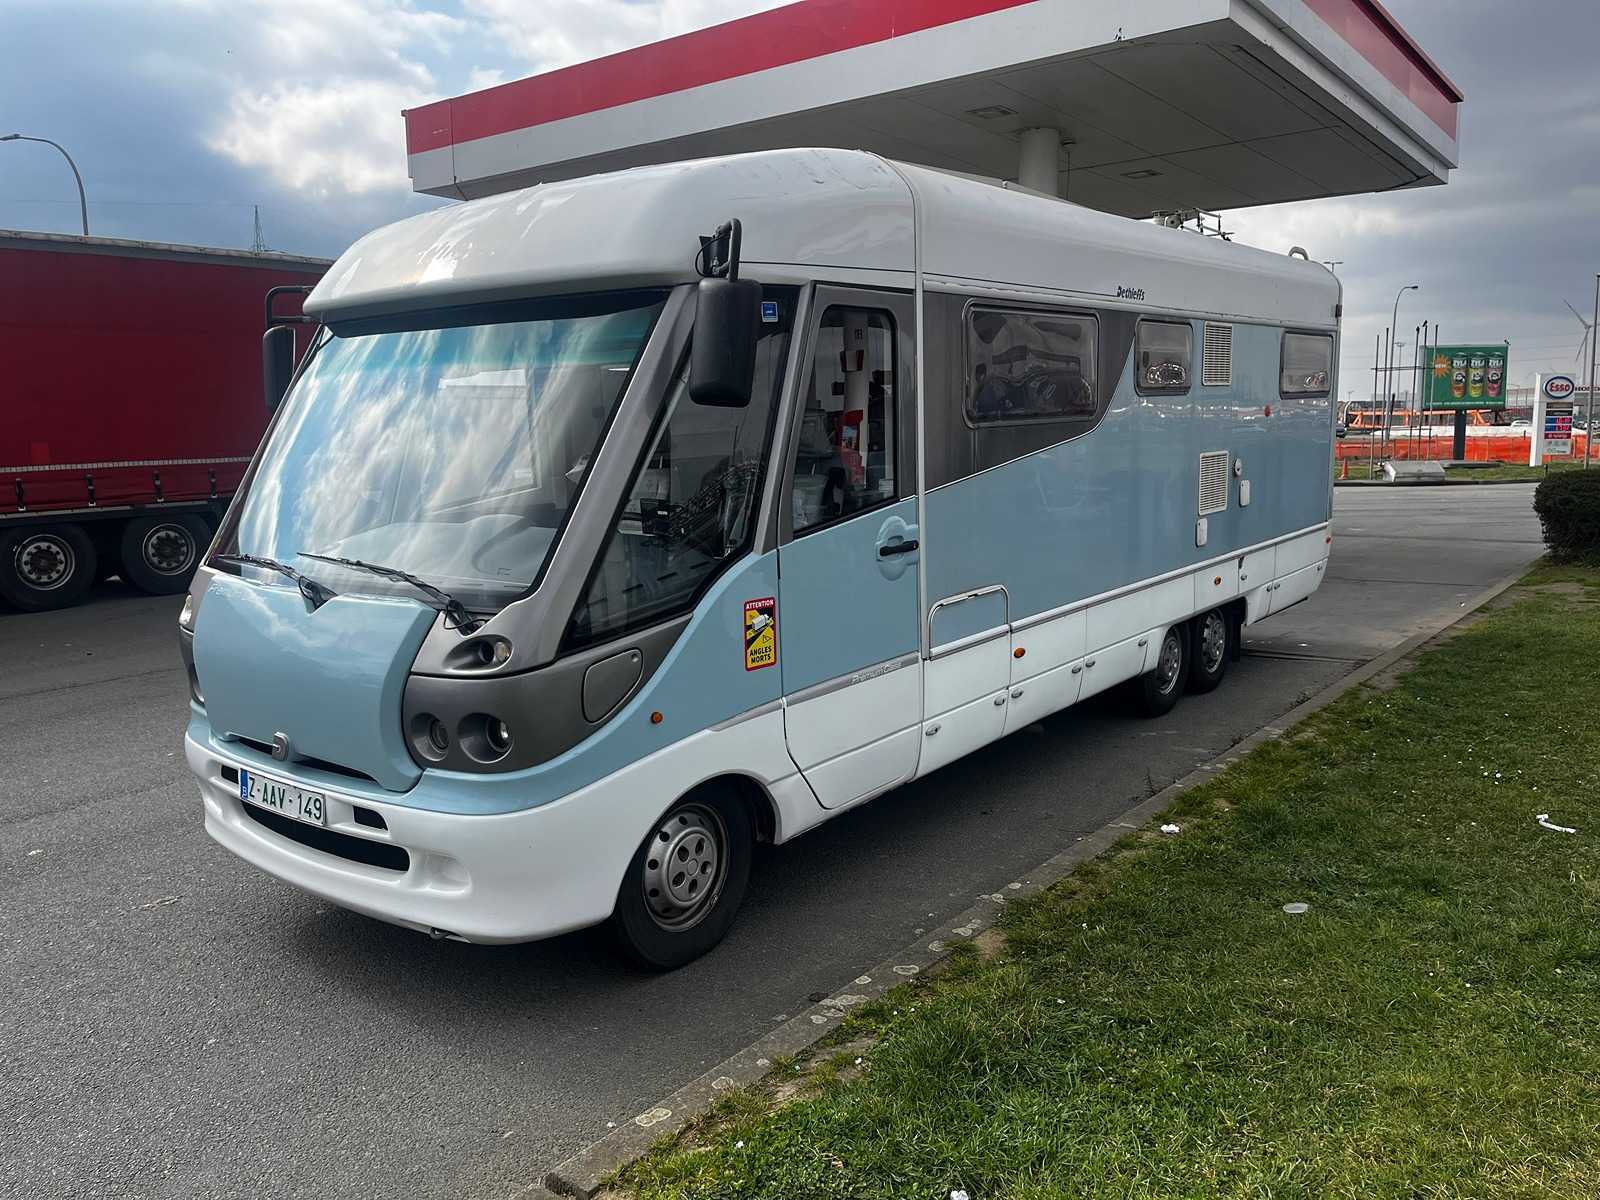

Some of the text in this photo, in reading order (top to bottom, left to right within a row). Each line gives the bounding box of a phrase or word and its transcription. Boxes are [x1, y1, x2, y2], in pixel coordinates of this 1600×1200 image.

[1549, 381, 1570, 392] Esso
[745, 599, 774, 610] ATTENTION
[749, 645, 772, 657] ANGLES
[750, 653, 772, 664] MORTS
